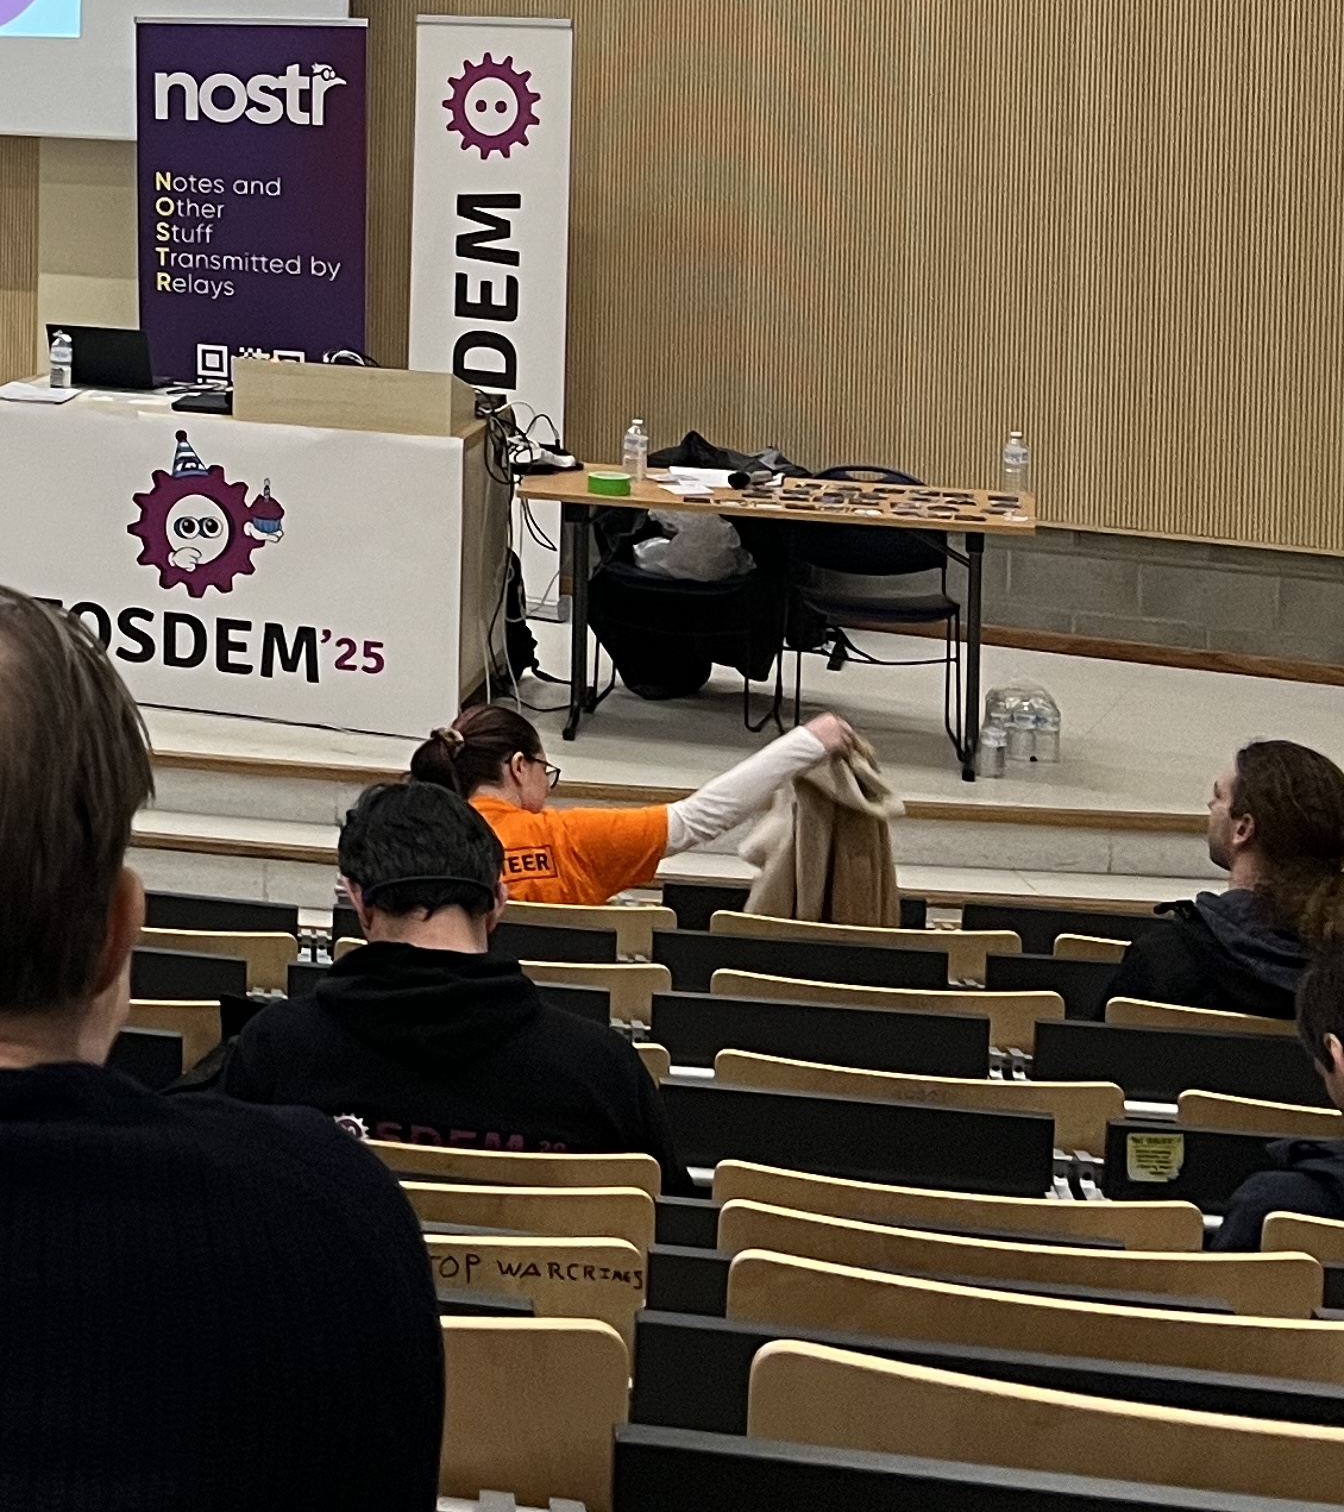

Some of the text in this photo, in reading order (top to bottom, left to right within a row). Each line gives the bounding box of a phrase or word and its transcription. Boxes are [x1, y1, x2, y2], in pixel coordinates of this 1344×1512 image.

[155, 63, 347, 126] nostr
[155, 171, 282, 196] Notes and
[155, 196, 225, 219] Other
[156, 222, 214, 243] Stuff
[155, 247, 341, 281] Transmitted by
[156, 272, 236, 299] Relays
[31, 597, 385, 683] OSDEM'25
